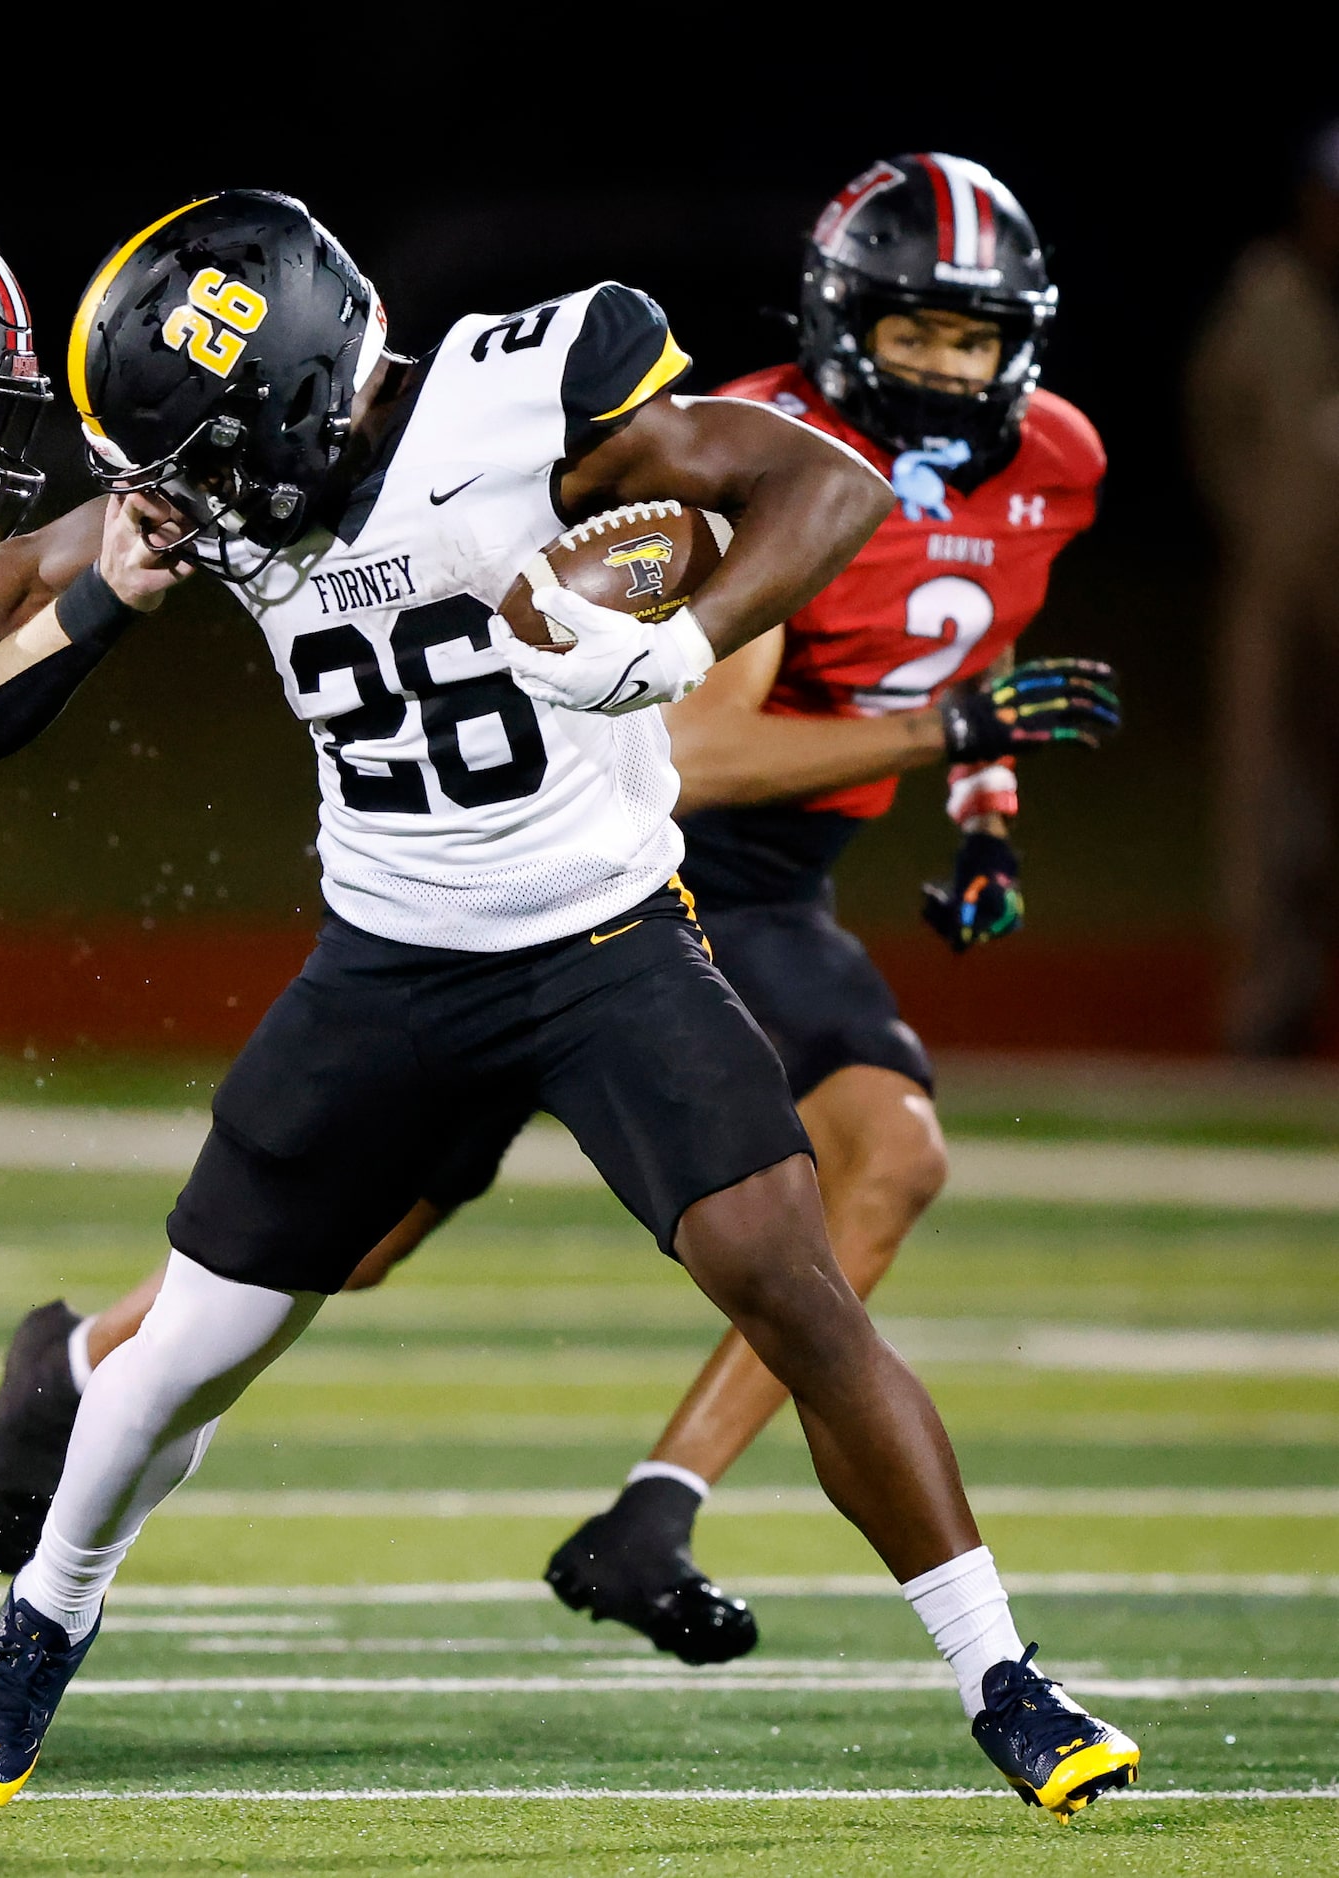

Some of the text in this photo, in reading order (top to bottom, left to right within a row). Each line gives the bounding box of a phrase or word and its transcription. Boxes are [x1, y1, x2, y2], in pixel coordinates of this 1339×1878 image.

[162, 266, 269, 379] 26
[310, 554, 417, 614] FORNEY
[629, 606, 657, 620] EAM
[853, 574, 995, 714] 2
[290, 592, 549, 815] 26
